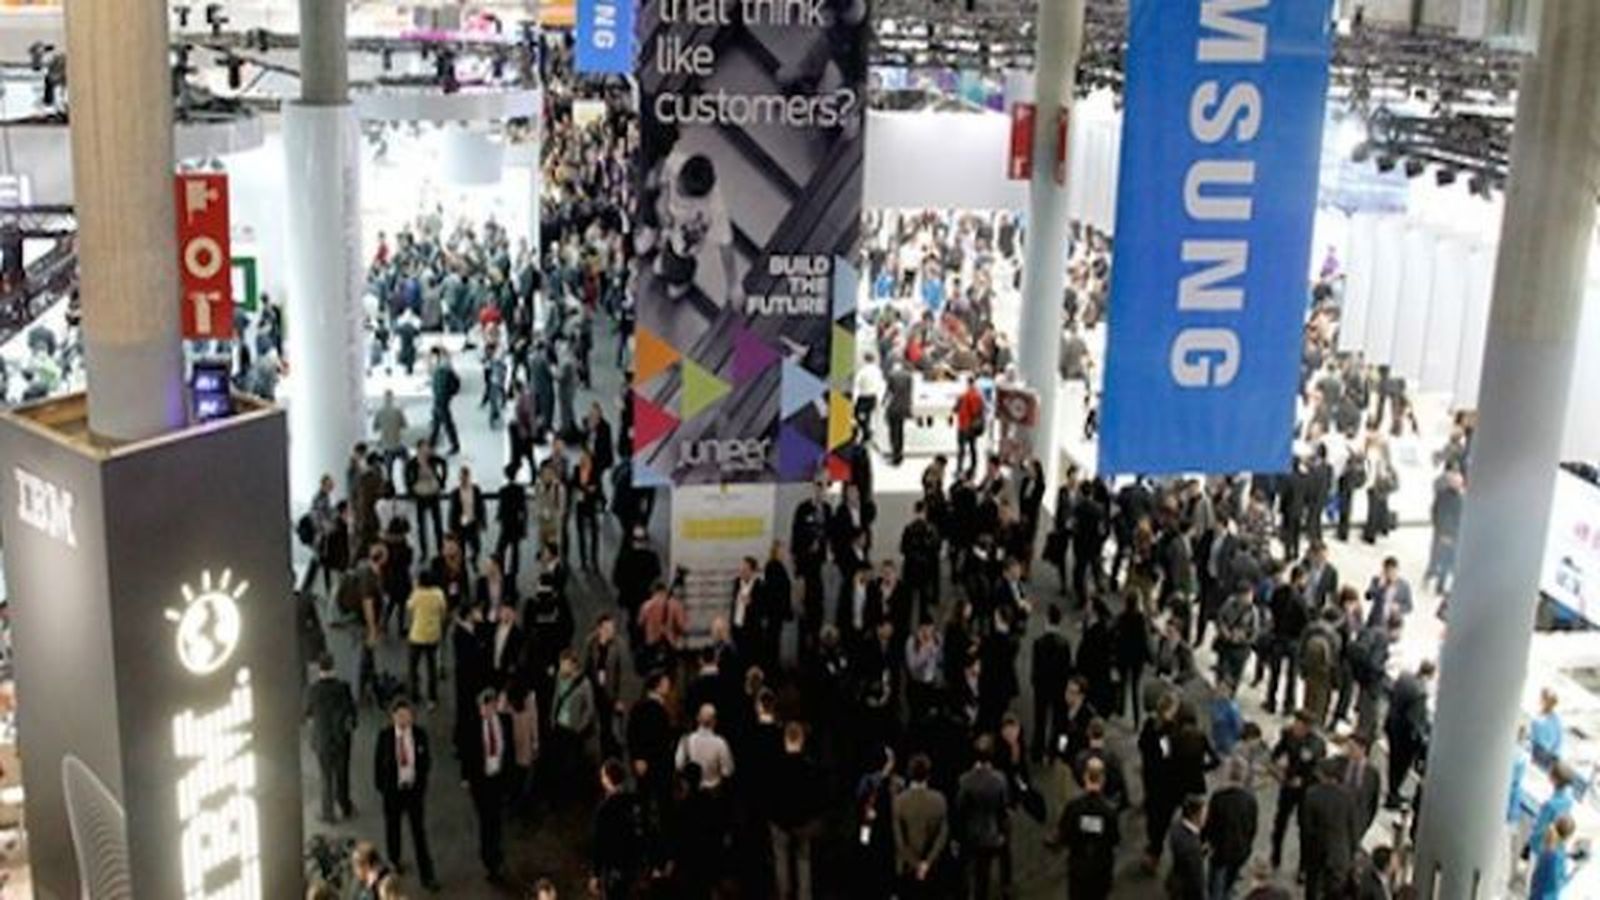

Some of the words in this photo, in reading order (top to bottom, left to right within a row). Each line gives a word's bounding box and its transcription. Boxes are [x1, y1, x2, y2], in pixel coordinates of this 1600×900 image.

[658, 0, 731, 25] that
[741, 0, 826, 27] think
[656, 35, 715, 76] like
[654, 87, 856, 127] customers?
[769, 254, 831, 276] BUILD
[788, 276, 829, 295] THE
[745, 295, 828, 316] FUTURE
[13, 467, 78, 549] IBM
